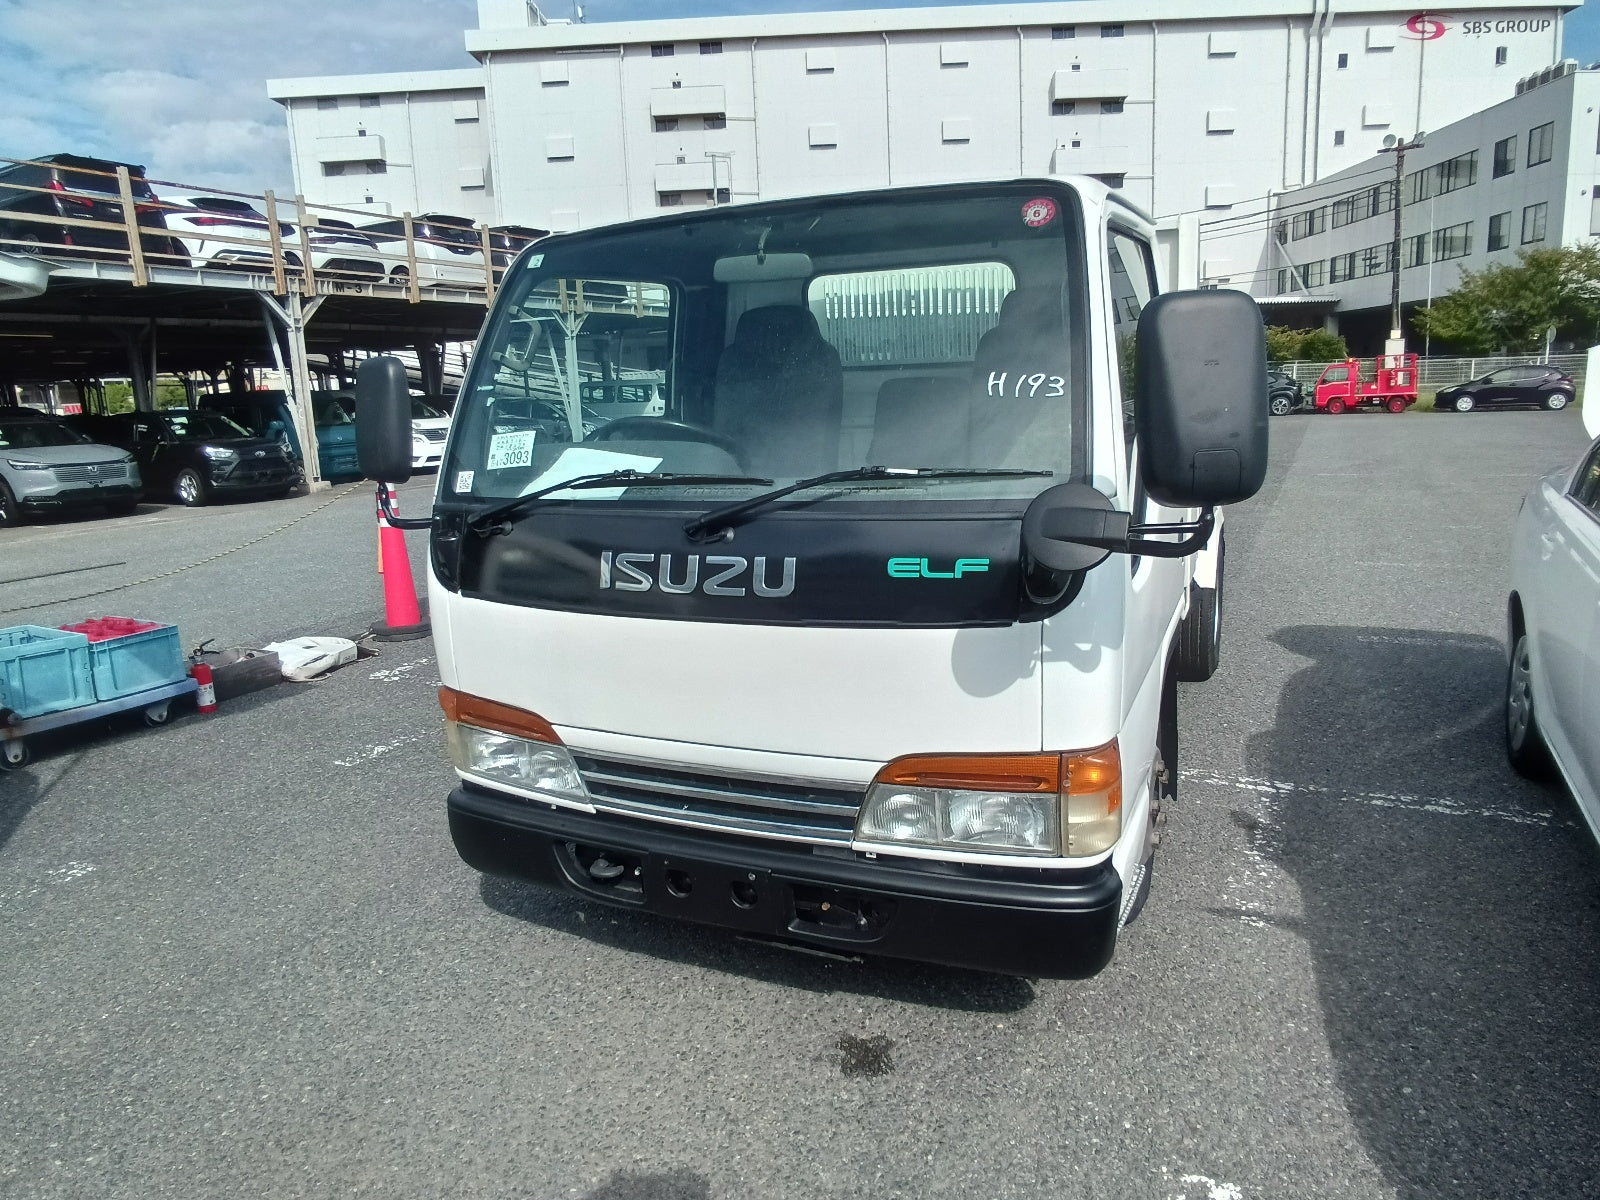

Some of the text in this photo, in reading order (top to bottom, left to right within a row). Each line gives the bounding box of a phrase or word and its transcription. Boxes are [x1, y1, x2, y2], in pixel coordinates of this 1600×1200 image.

[1462, 19, 1551, 35] SBS GROUP
[1033, 209, 1041, 218] 6
[534, 258, 540, 267] 2
[502, 450, 529, 466] 3093
[599, 550, 797, 598] ISUZU
[887, 557, 990, 579] ELF
